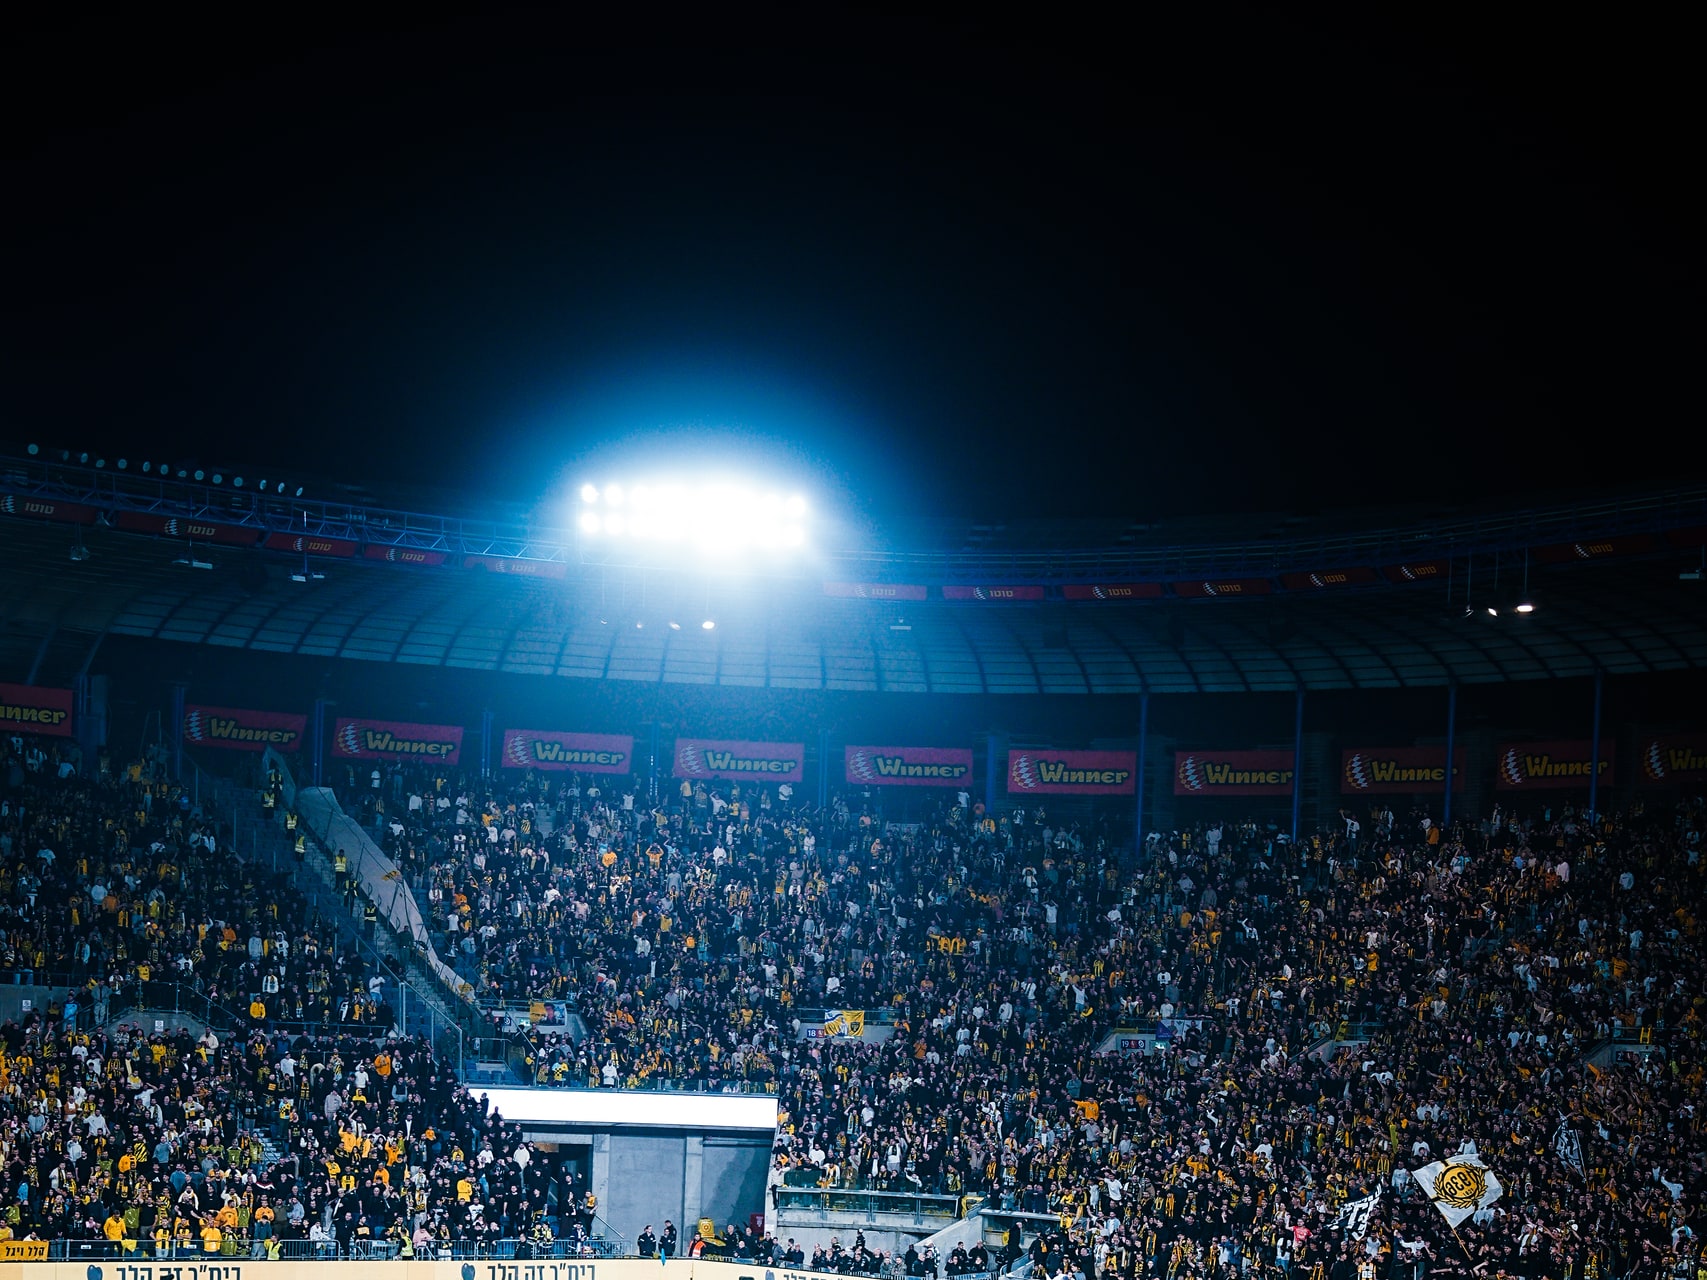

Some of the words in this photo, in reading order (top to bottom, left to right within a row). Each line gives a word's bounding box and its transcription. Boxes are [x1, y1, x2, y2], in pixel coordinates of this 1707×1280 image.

[0, 705, 66, 724] inner
[210, 716, 296, 744] Winner
[365, 730, 455, 756] Winner
[535, 741, 624, 766] Winner
[706, 751, 796, 773] Winner
[875, 757, 966, 777] Winner
[1040, 761, 1128, 784] Winner
[1204, 763, 1293, 784] Winner
[1525, 754, 1608, 777] Winner
